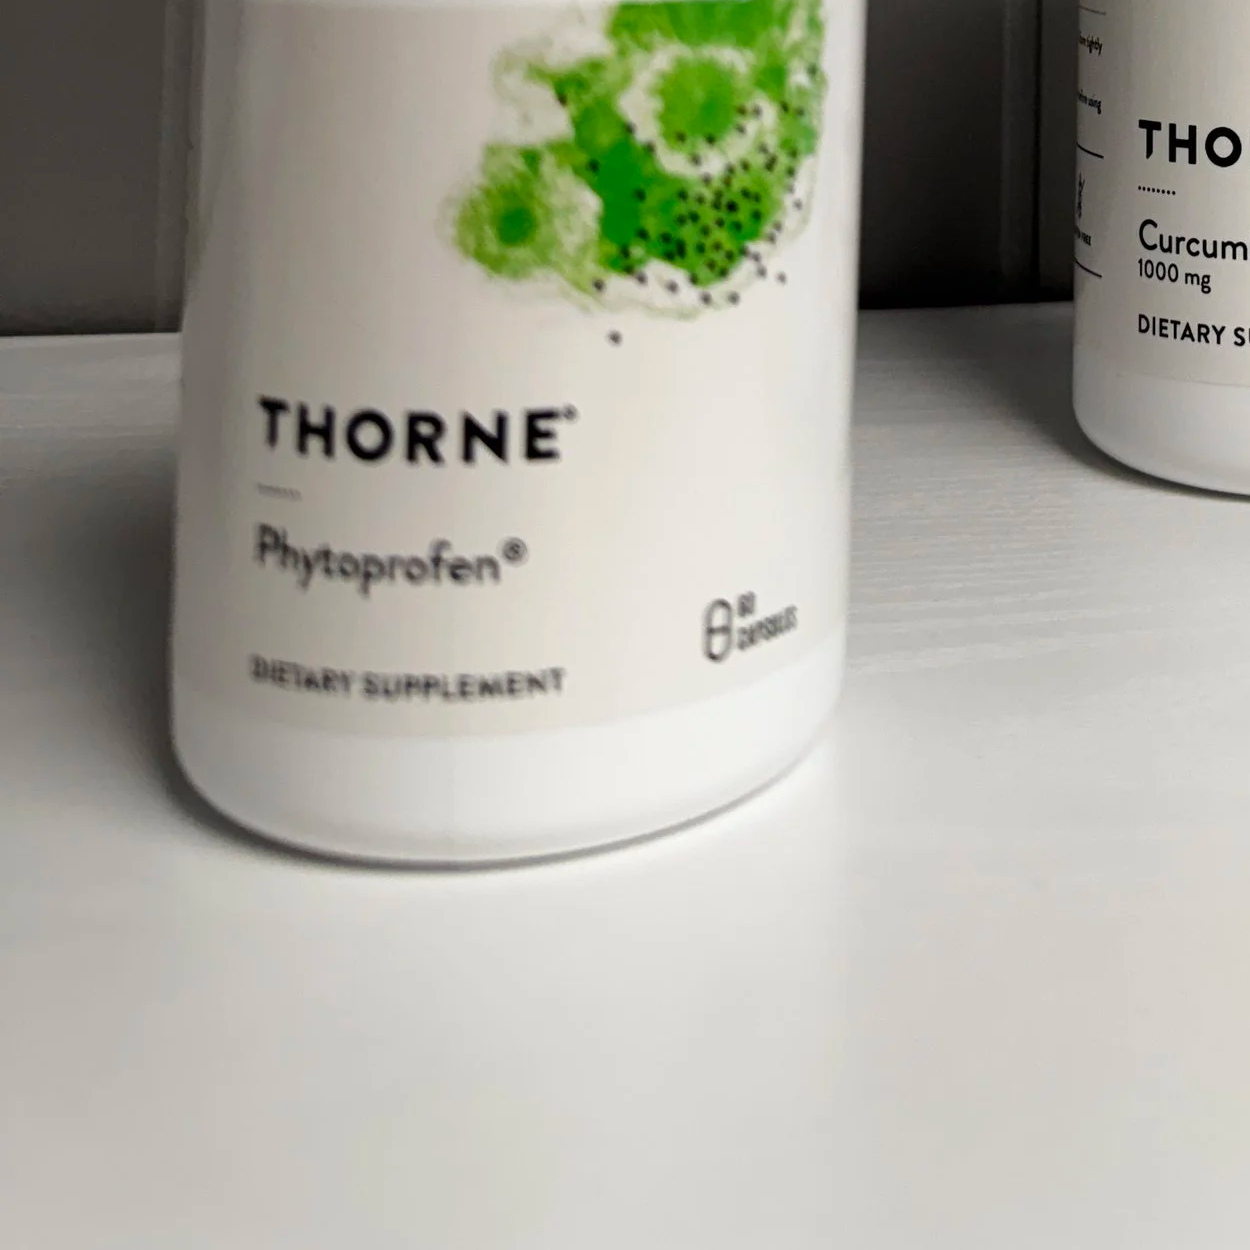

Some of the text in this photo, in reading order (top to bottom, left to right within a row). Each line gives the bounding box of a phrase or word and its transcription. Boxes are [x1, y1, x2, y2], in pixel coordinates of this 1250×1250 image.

[1138, 258, 1211, 294] 1000 mg
[1138, 314, 1226, 345] DIETARY
[249, 654, 566, 702] DIETARY SUPPLEMENT
